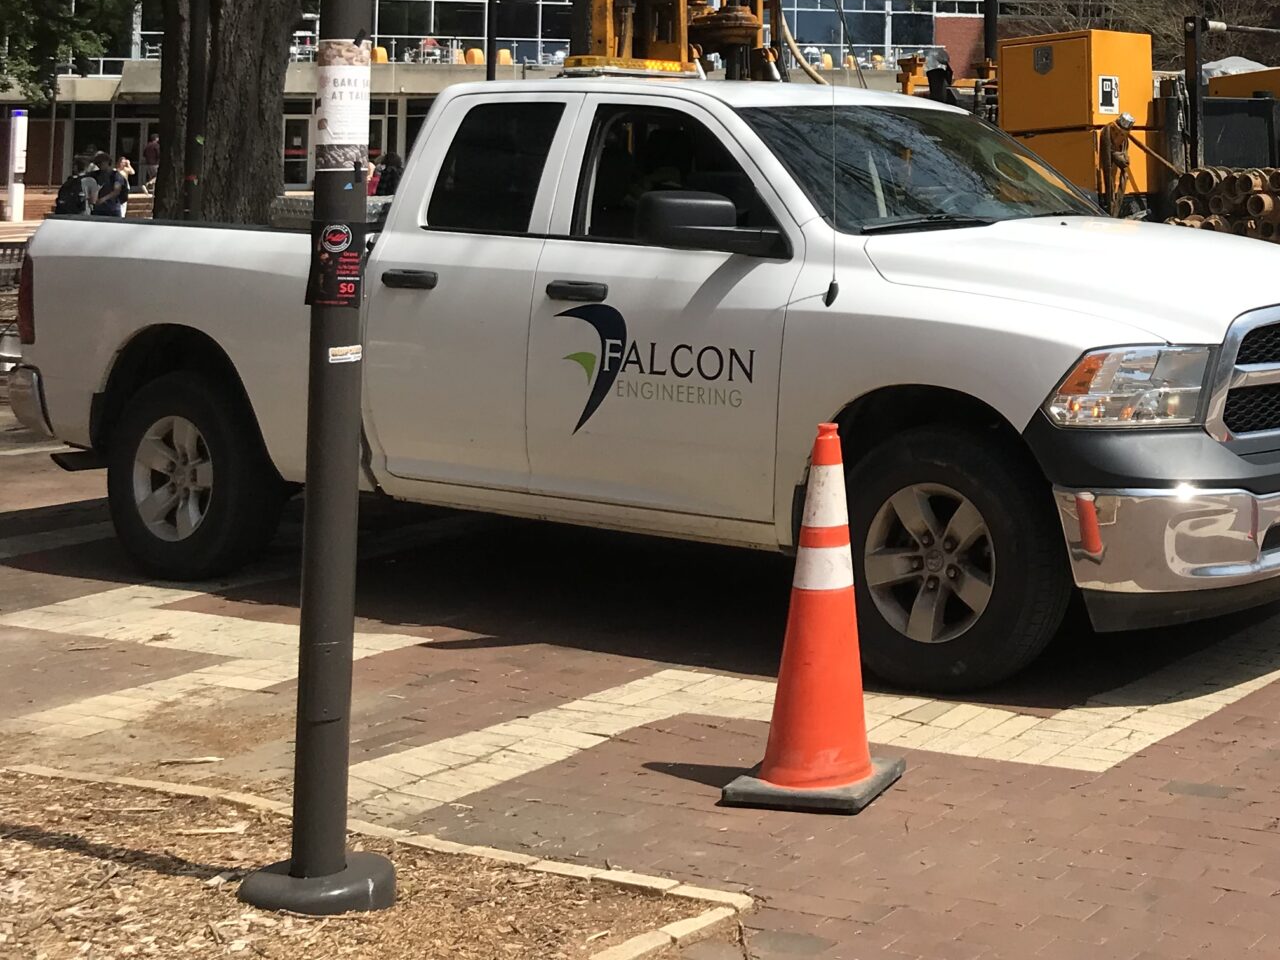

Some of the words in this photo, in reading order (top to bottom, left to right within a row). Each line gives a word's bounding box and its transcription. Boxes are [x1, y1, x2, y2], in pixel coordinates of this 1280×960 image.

[332, 91, 344, 101] AT
[602, 339, 756, 384] FALCON
[616, 379, 743, 408] ENGINEERING
